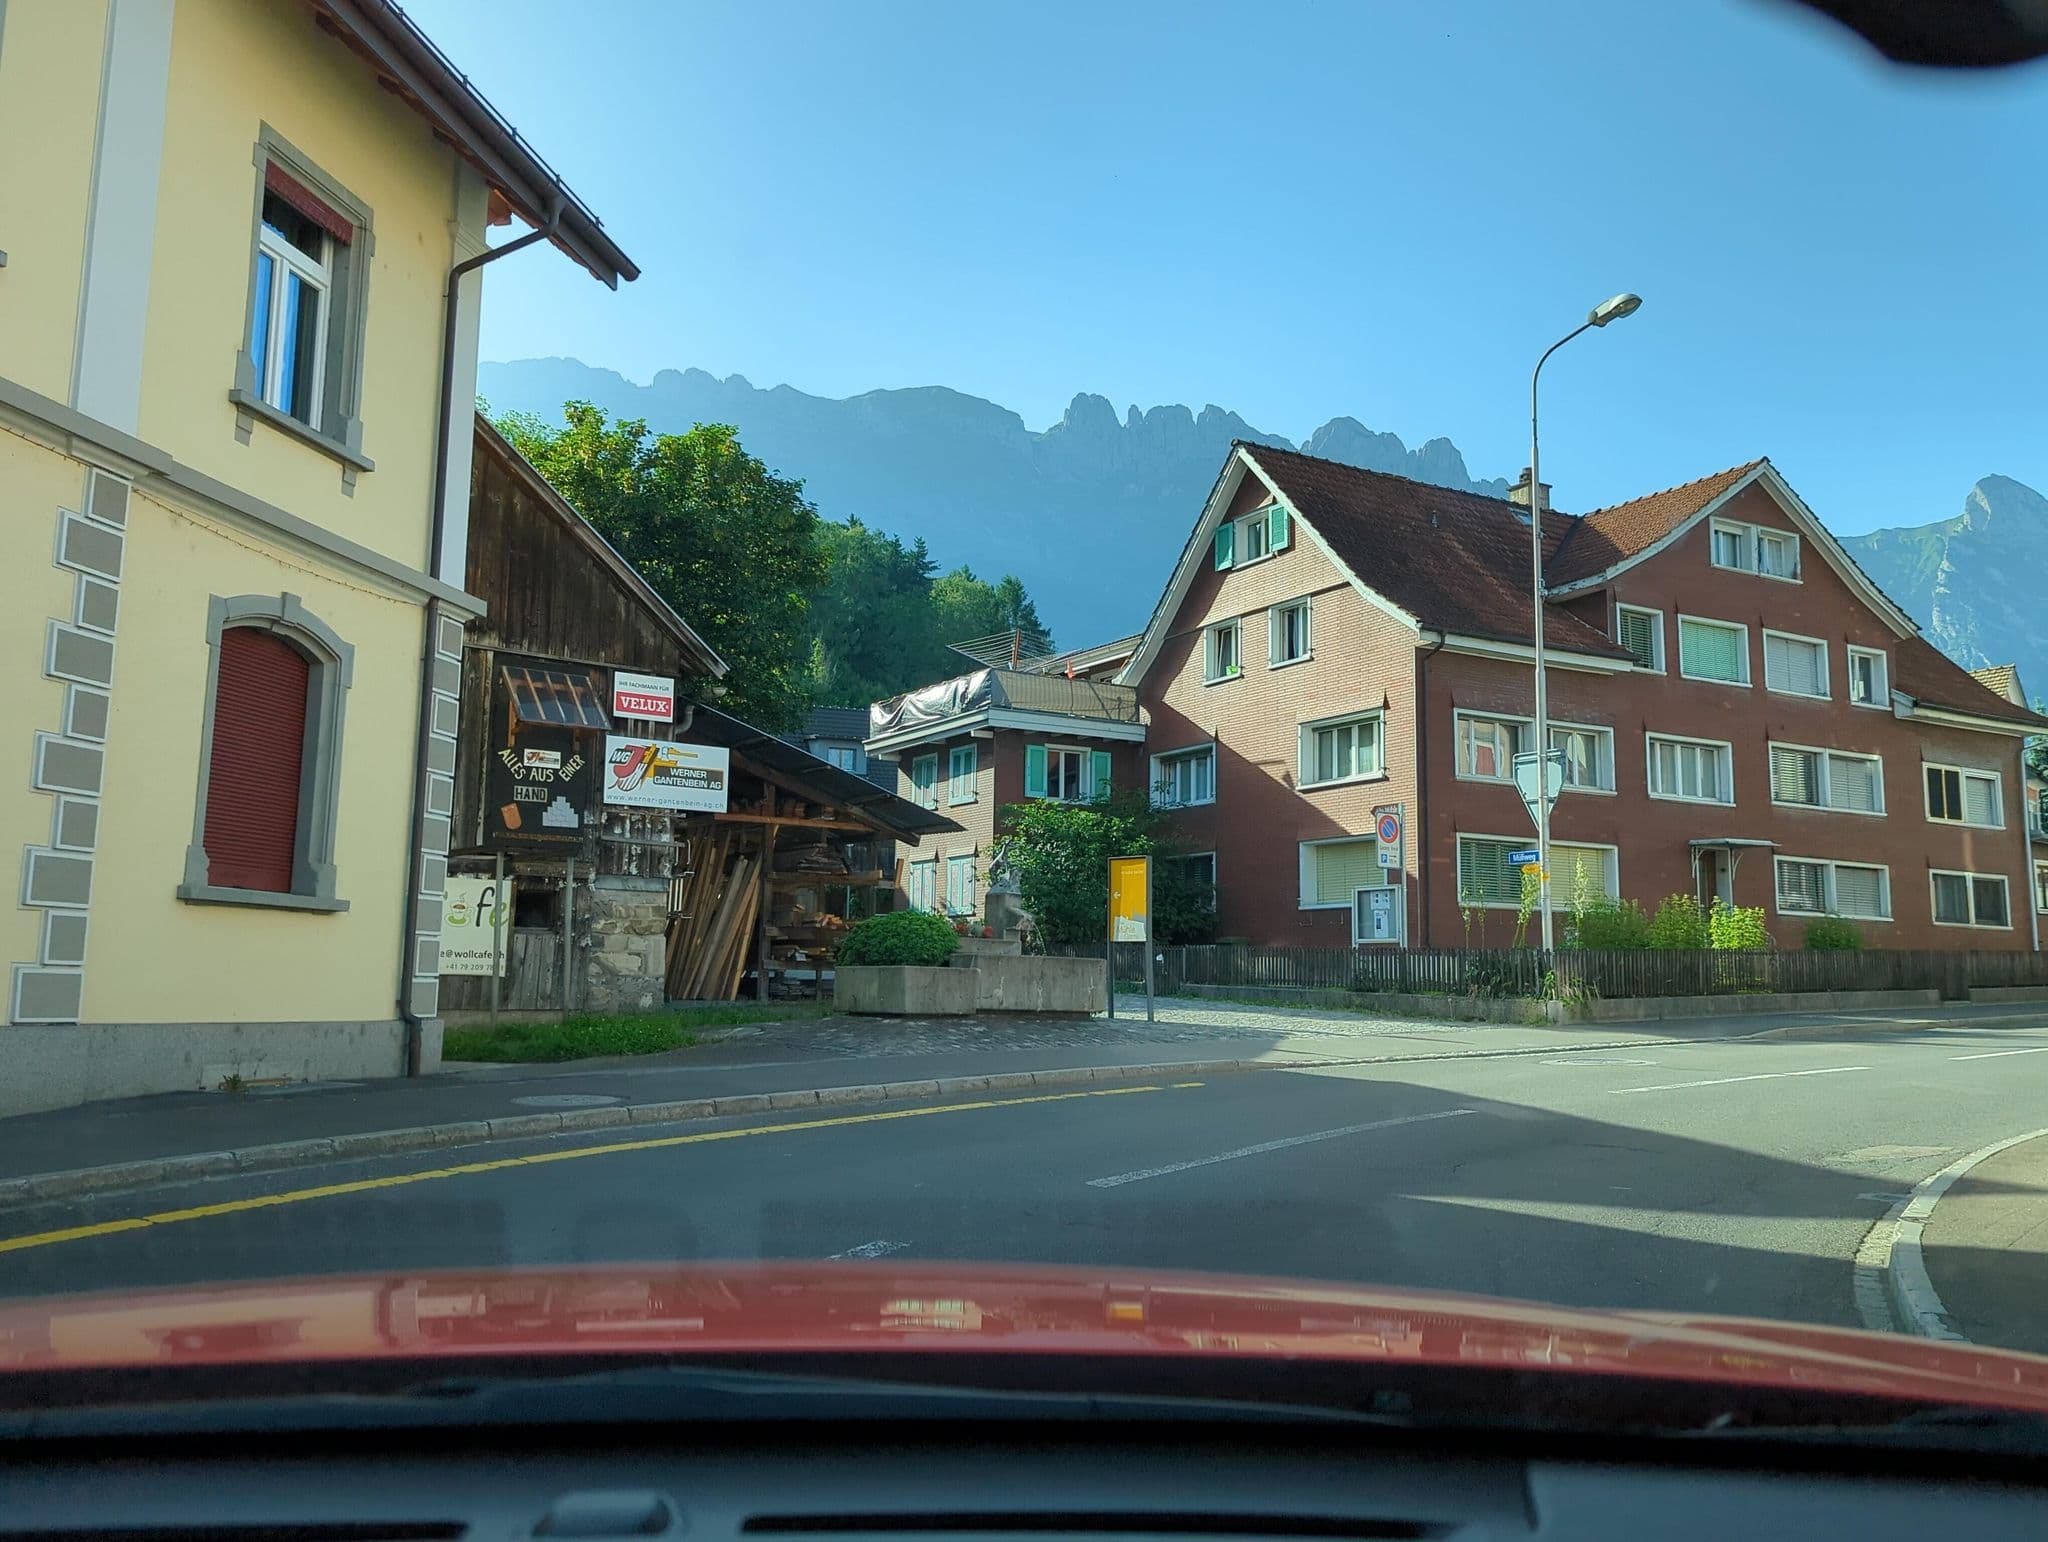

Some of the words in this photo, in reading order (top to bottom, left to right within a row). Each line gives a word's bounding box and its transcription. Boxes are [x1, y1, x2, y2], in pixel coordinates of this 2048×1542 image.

[629, 681, 659, 691] FACHMANN
[620, 695, 668, 713] VELUX
[610, 749, 631, 764] WG
[497, 748, 527, 780] ALLES
[529, 767, 554, 782] AUS
[558, 754, 586, 782] EINER
[670, 767, 708, 779] WERNER
[654, 775, 708, 788] GANTENBEIN
[709, 781, 722, 790] AG
[514, 785, 547, 802] HAND
[607, 793, 724, 809] www.werner-gantenbein-ag.ch
